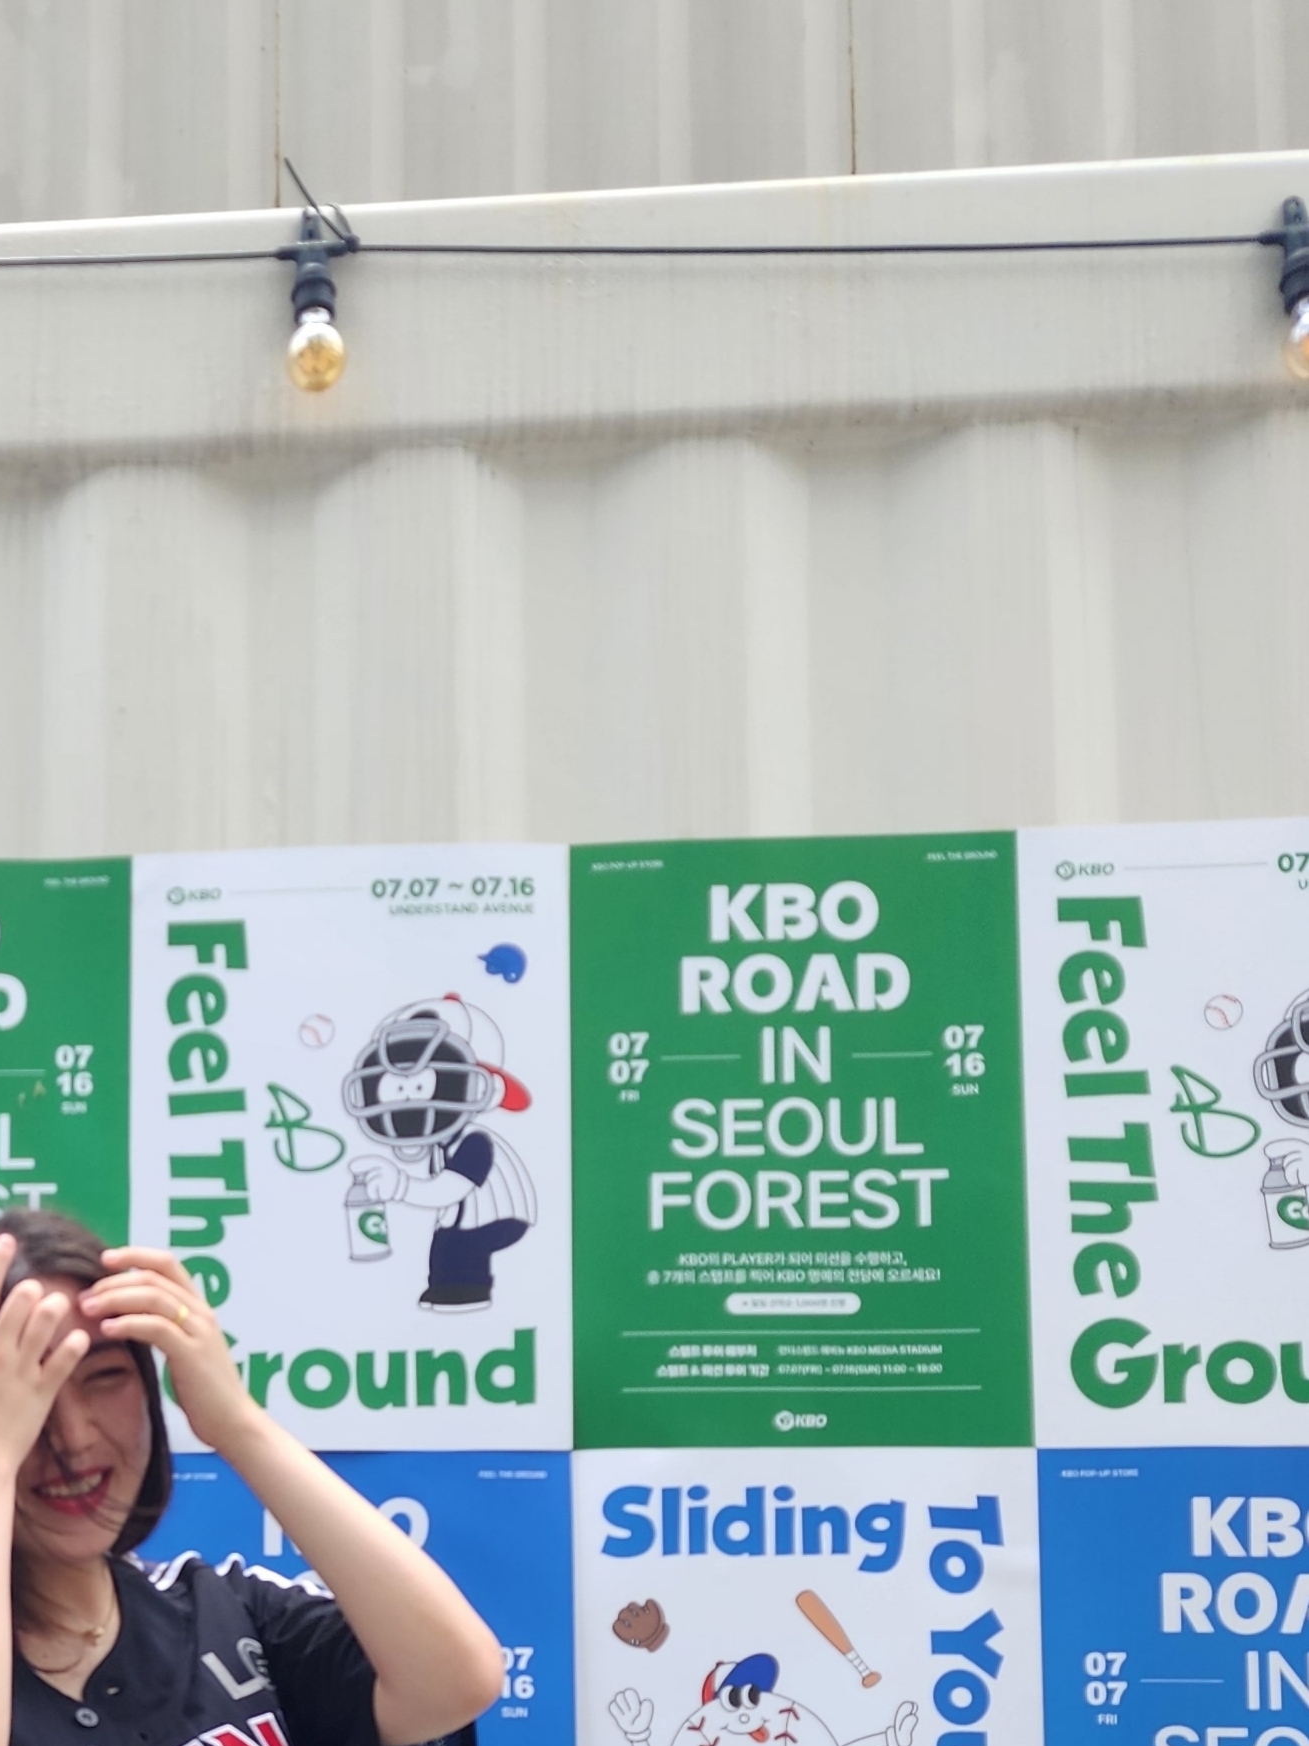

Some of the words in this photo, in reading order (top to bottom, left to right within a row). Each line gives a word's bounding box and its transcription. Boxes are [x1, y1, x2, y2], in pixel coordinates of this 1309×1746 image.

[1078, 863, 1114, 876] KBO
[371, 878, 439, 899] 07.07
[471, 877, 534, 897] 07.16
[710, 881, 879, 942] KBO
[681, 953, 910, 1014] ROAD
[1057, 896, 1150, 1098] Feel
[166, 920, 248, 1116] Feel
[609, 1032, 649, 1060] 07
[943, 1025, 984, 1049] 07
[55, 1045, 93, 1070] 07
[762, 1026, 831, 1083] IN
[945, 1053, 985, 1076] 16
[57, 1072, 93, 1096] 16
[609, 1059, 649, 1084] 07
[620, 1090, 639, 1101] FRI
[952, 1084, 978, 1095] SUN
[61, 1101, 87, 1114] SUN
[671, 1097, 924, 1158] SEOUL
[650, 1169, 949, 1230] FOREST
[1068, 1122, 1158, 1298] The
[169, 1138, 251, 1308] The
[248, 1326, 538, 1411] round
[794, 1414, 827, 1427] KBO
[601, 1485, 905, 1573] Sliding
[1192, 1496, 1309, 1557] KB
[928, 1495, 1003, 1594] To
[1162, 1572, 1309, 1634] RO
[1085, 1652, 1126, 1676] 07
[1086, 1681, 1127, 1705] 07
[502, 1707, 528, 1717] SUN
[1098, 1714, 1117, 1724] FRI
